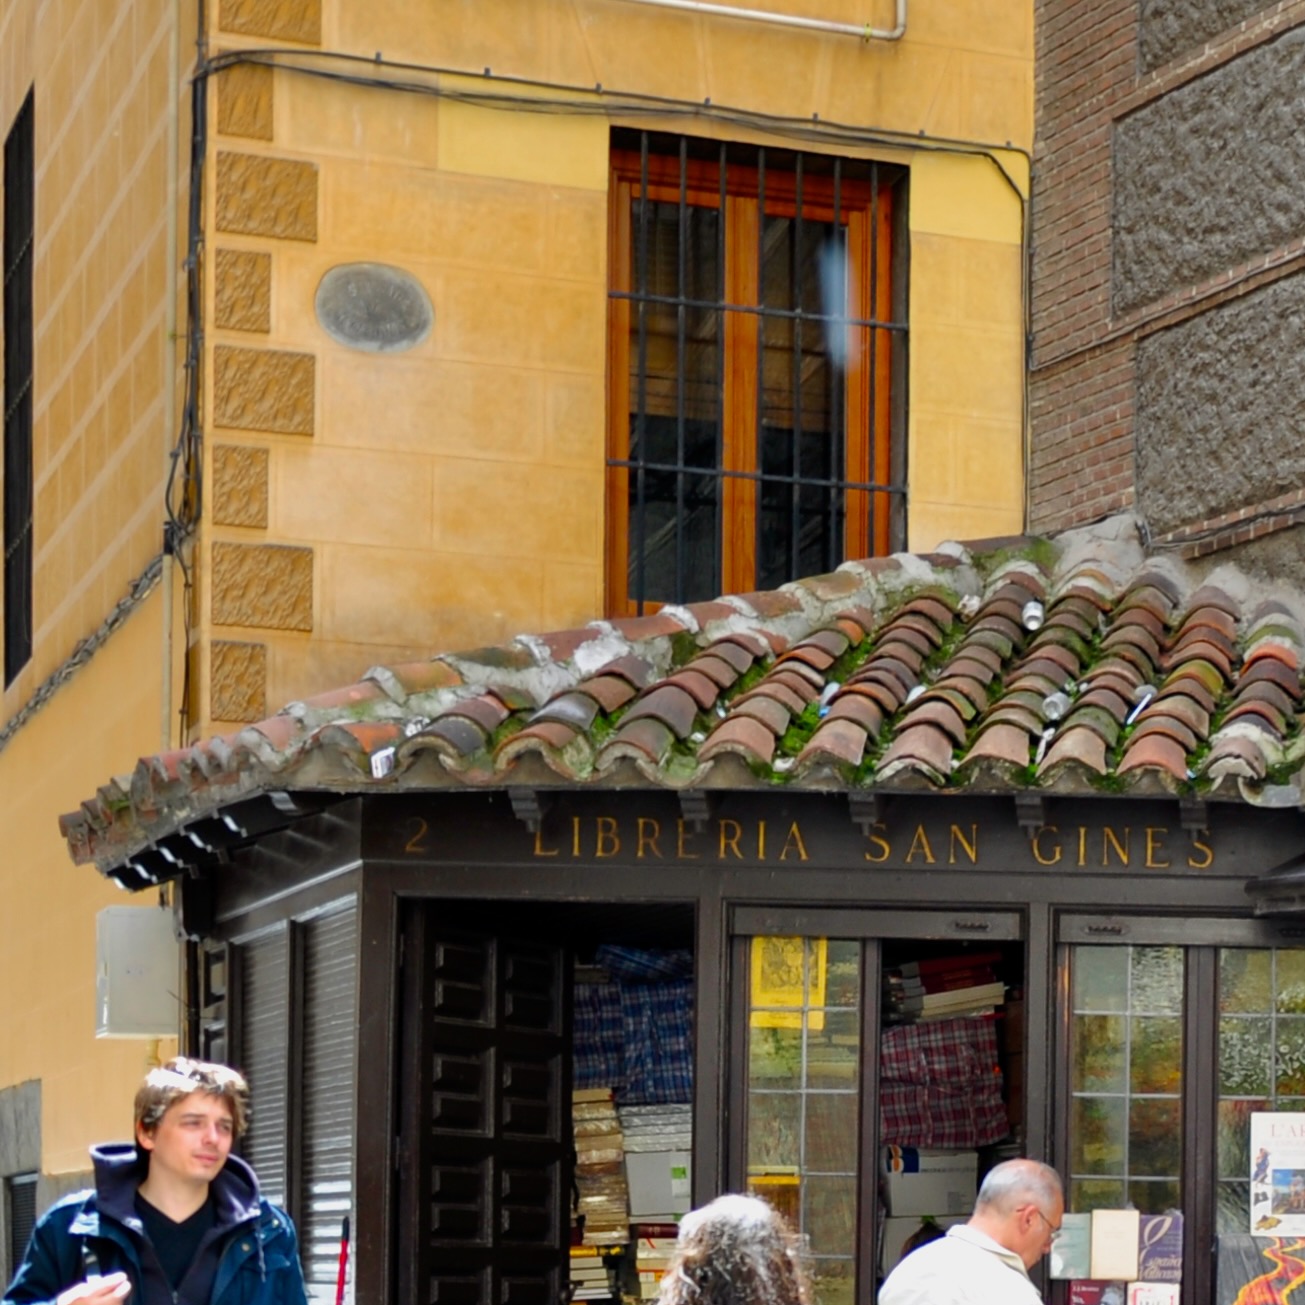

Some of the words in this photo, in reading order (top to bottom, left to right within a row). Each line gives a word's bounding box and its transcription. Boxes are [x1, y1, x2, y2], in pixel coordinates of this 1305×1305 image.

[405, 817, 428, 853] 2
[533, 816, 809, 861] LIBRERIA
[864, 823, 978, 865] SAN
[1031, 826, 1215, 869] GINES
